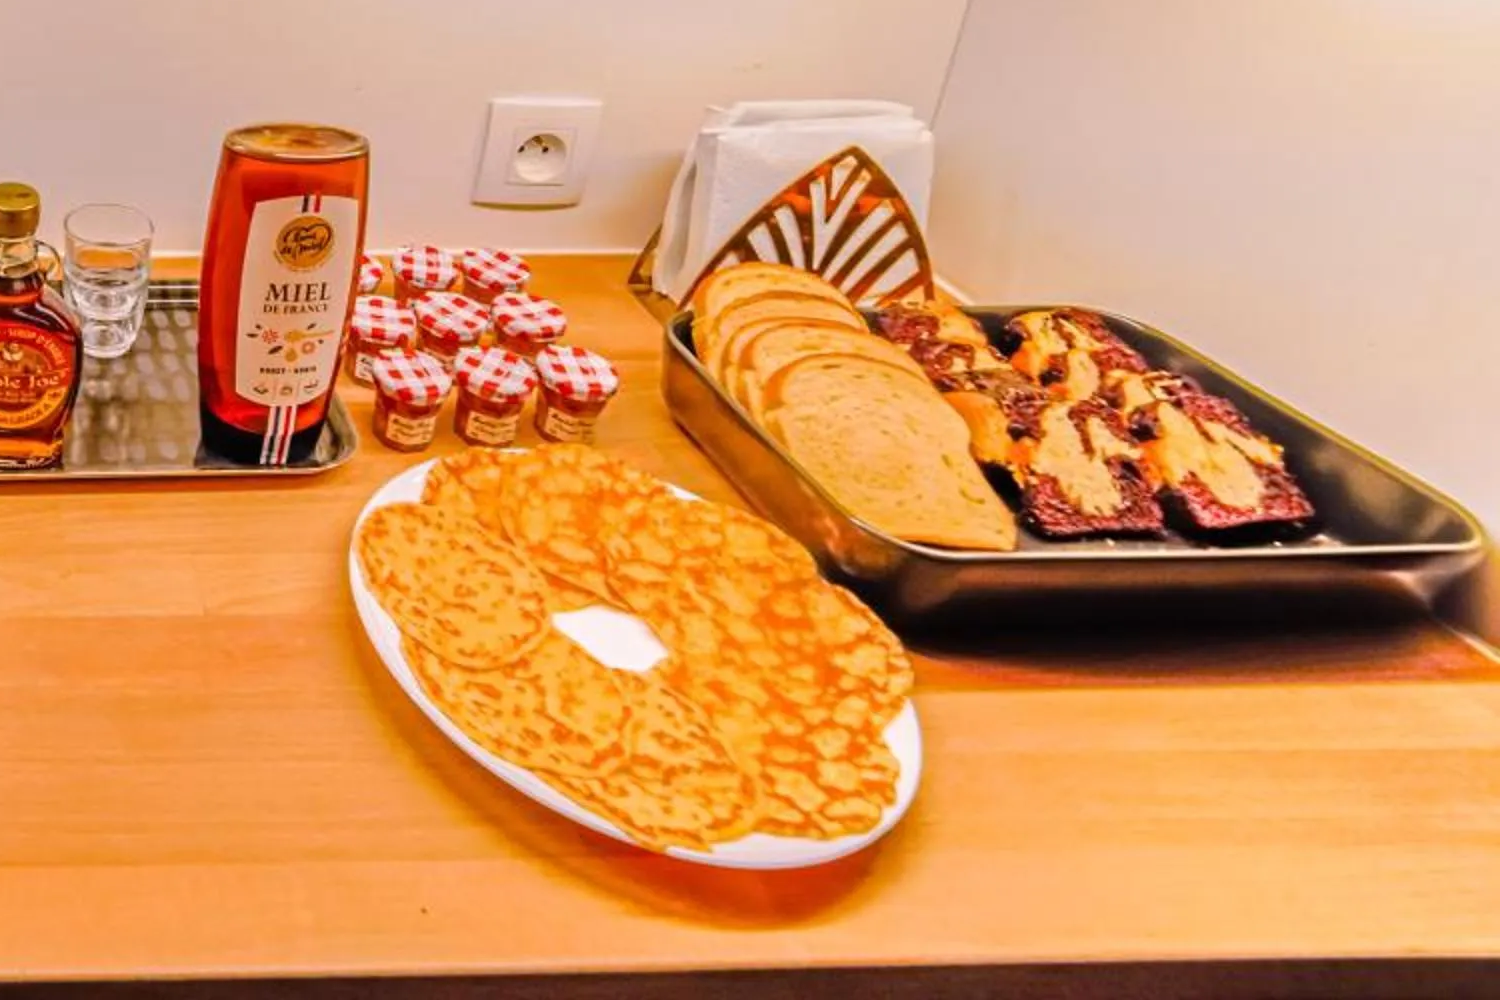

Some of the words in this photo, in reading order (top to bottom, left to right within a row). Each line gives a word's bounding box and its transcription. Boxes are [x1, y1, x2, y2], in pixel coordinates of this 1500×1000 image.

[264, 282, 331, 302] MIEL
[263, 303, 278, 314] DE
[283, 303, 329, 315] FRANCE
[29, 373, 60, 389] Joe
